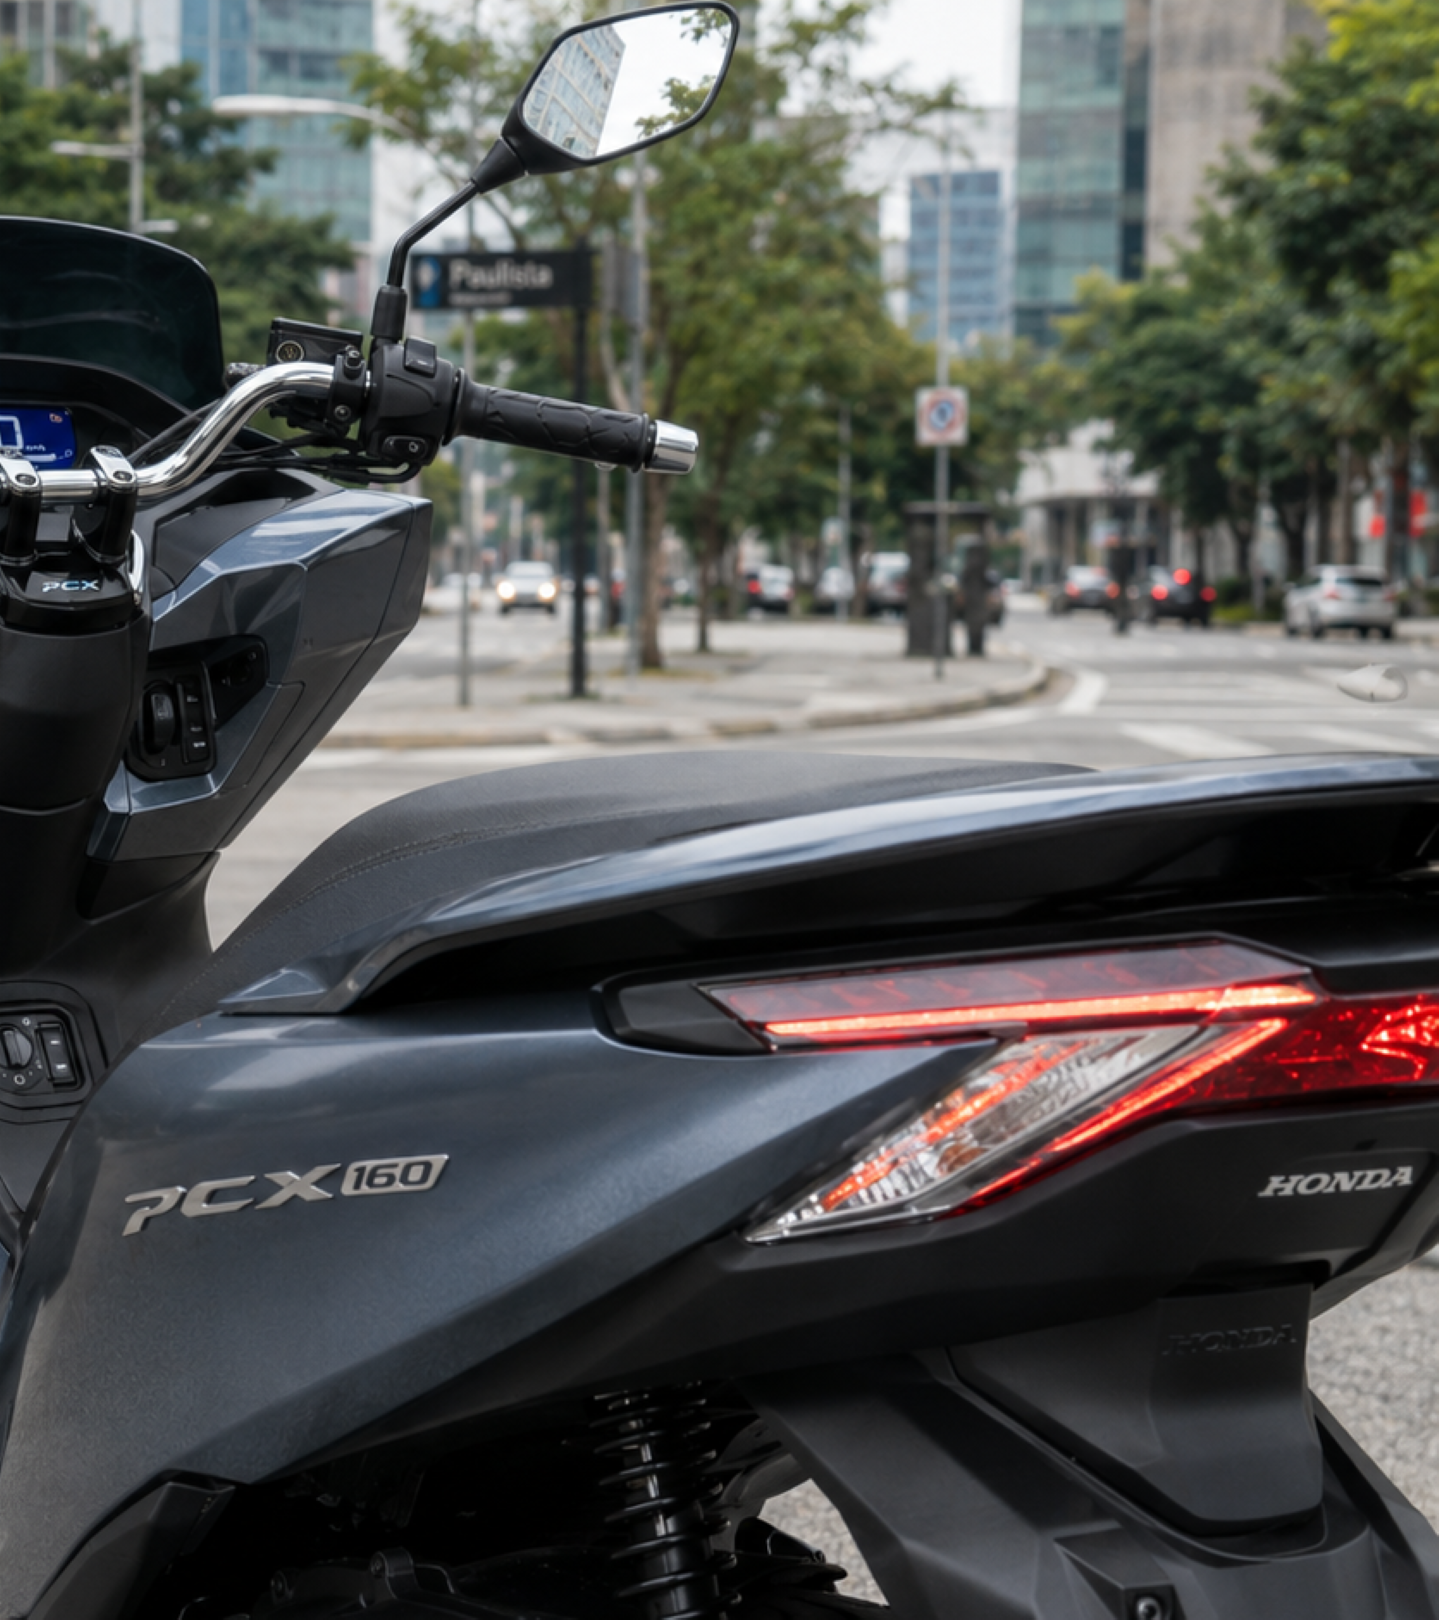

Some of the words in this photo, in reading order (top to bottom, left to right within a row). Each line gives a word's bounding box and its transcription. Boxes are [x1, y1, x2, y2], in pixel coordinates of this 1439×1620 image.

[449, 259, 553, 289] Paulista
[42, 580, 99, 592] PCX
[1257, 1166, 1413, 1197] HONDA
[122, 1163, 341, 1236] PCX
[352, 1160, 433, 1192] 160
[1162, 1324, 1298, 1356] HONDA
